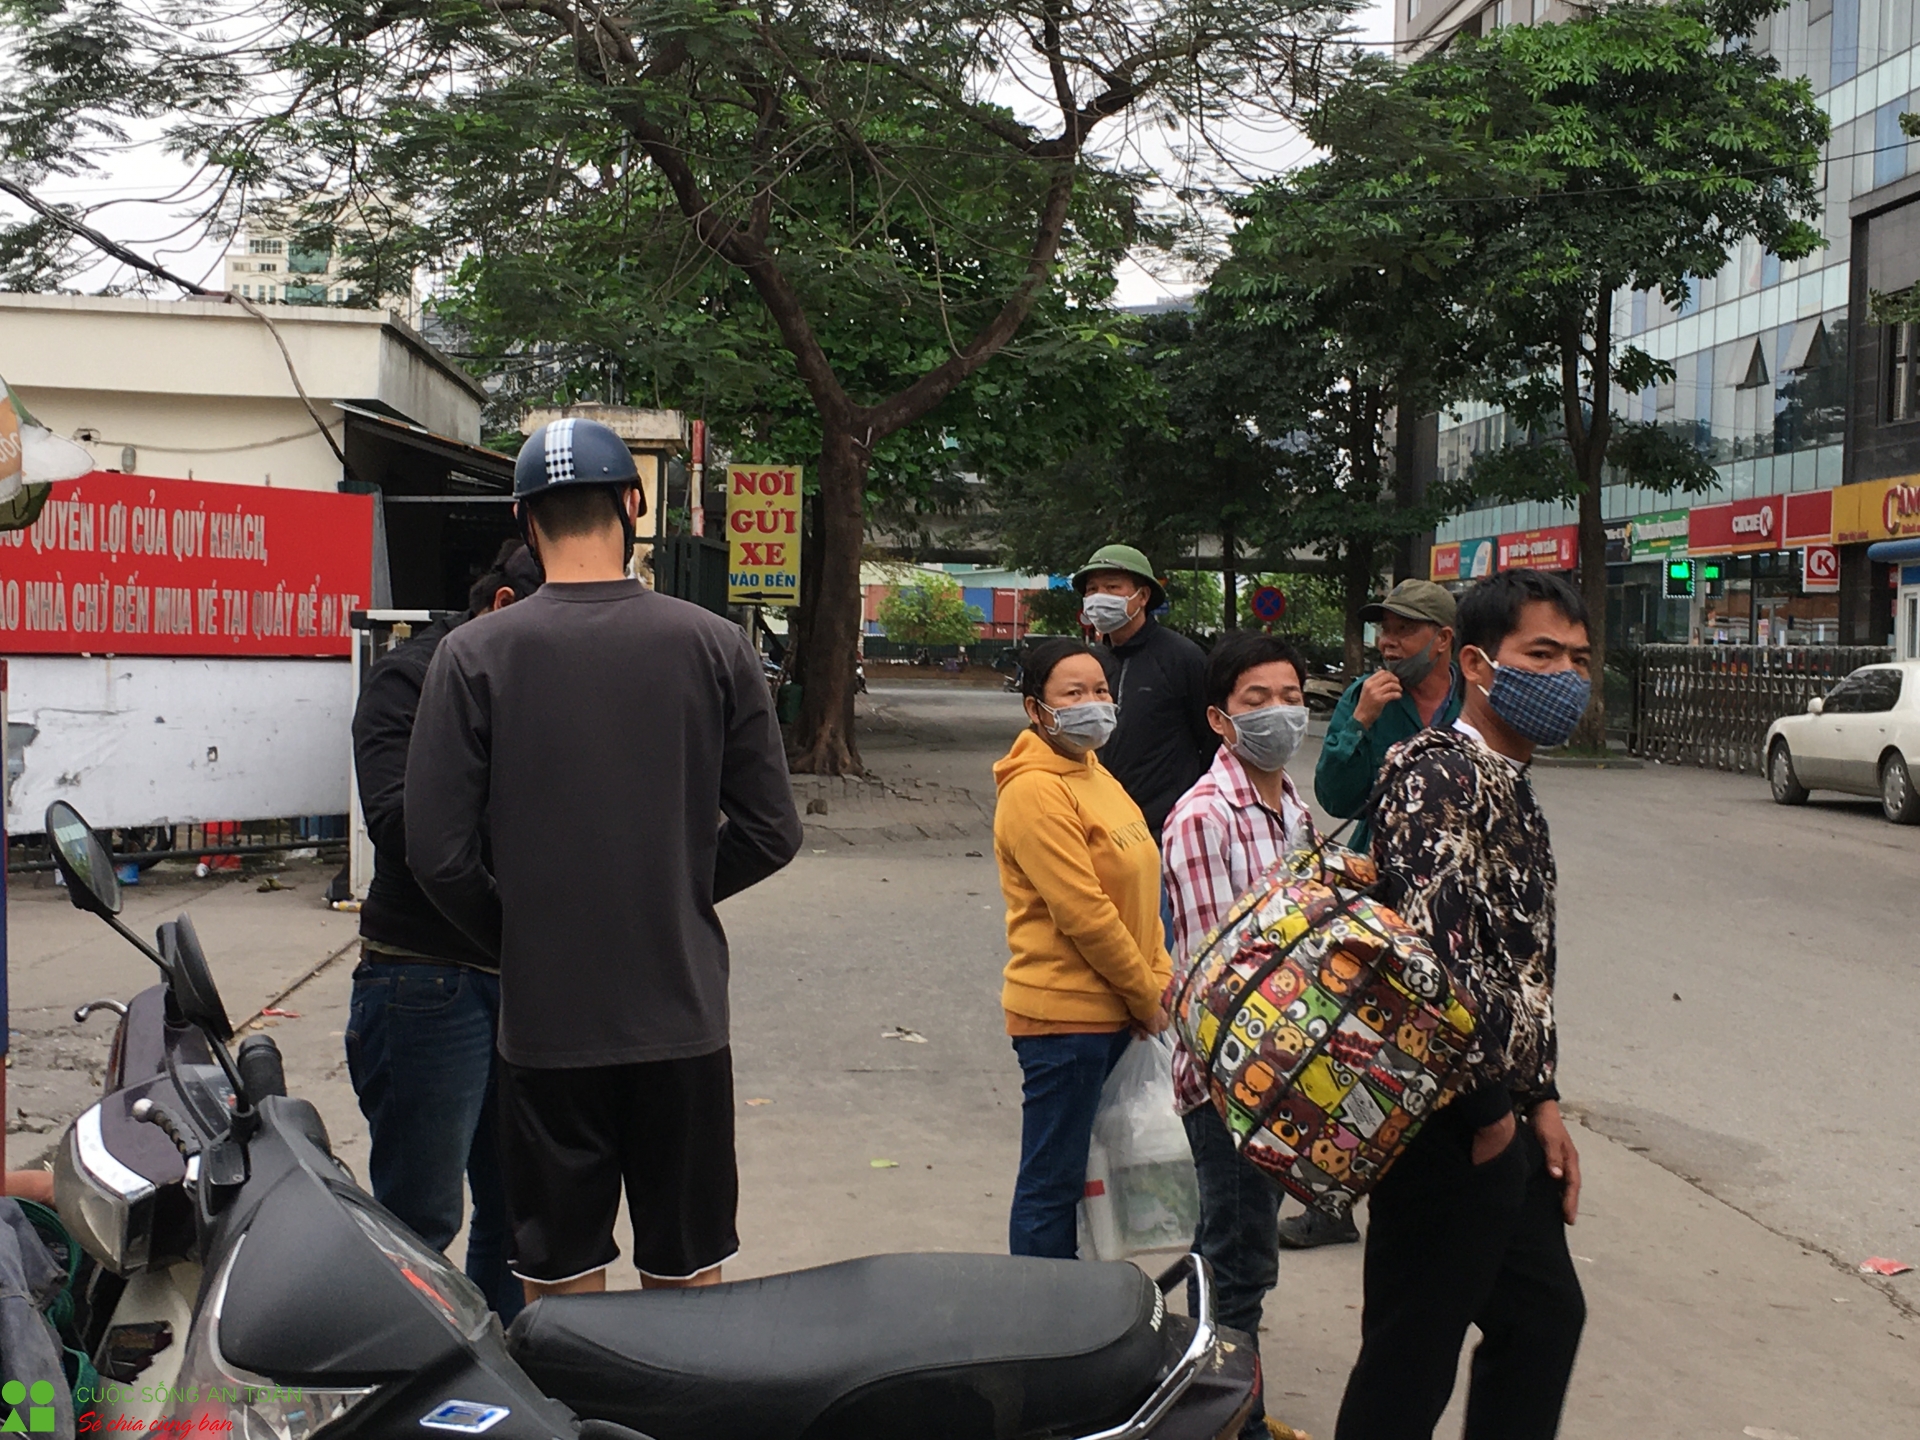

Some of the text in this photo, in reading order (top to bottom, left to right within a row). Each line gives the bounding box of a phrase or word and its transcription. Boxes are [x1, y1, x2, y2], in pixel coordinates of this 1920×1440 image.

[733, 469, 796, 496] NƠI
[100, 501, 127, 563] LỢI
[132, 489, 167, 556] CỦA
[172, 501, 206, 562] QUÝ
[210, 504, 267, 566] KHÁCH,
[730, 500, 797, 534] GỬI
[738, 542, 786, 566] XE
[1813, 553, 1835, 573] K
[729, 571, 759, 587] VÀO
[25, 571, 67, 632] NHÀ
[72, 572, 109, 633] CHỜ
[113, 570, 149, 634] BẾN
[154, 587, 192, 635] MUA
[198, 579, 217, 635] VÉ
[222, 589, 248, 643] TẠI
[252, 579, 295, 641] QUẦY
[321, 593, 338, 637] ĐI
